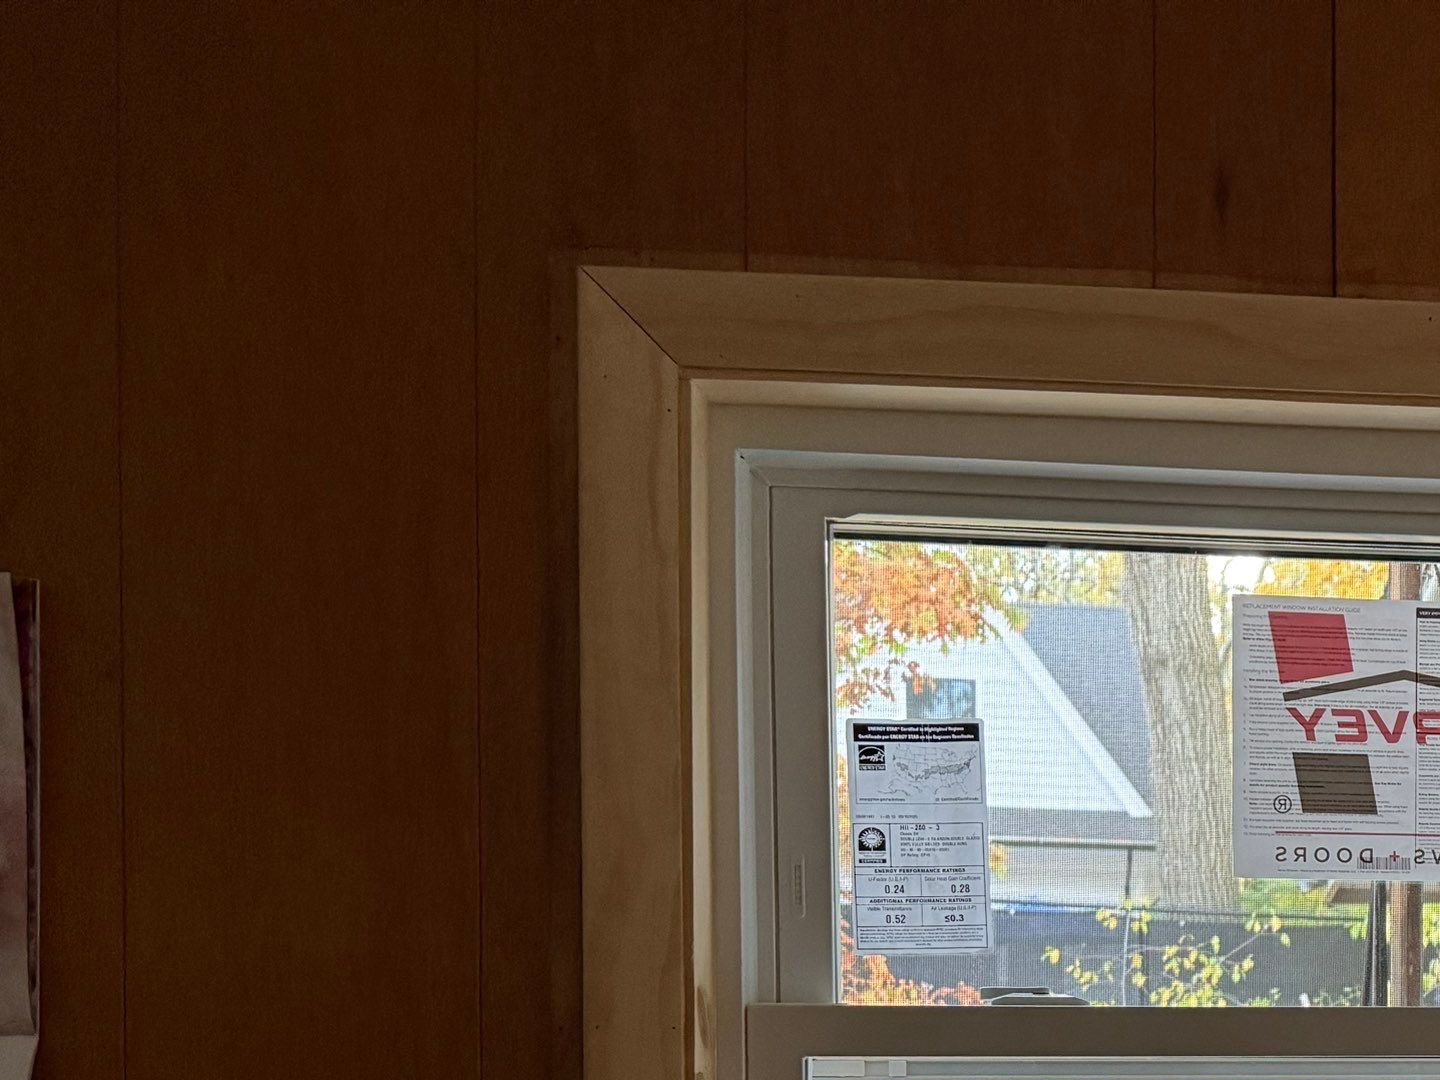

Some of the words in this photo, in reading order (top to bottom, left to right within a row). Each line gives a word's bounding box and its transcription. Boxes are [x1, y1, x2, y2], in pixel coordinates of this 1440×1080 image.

[884, 884, 905, 894] 0.24
[950, 883, 971, 893] 0.28
[885, 914, 906, 924] 0.52
